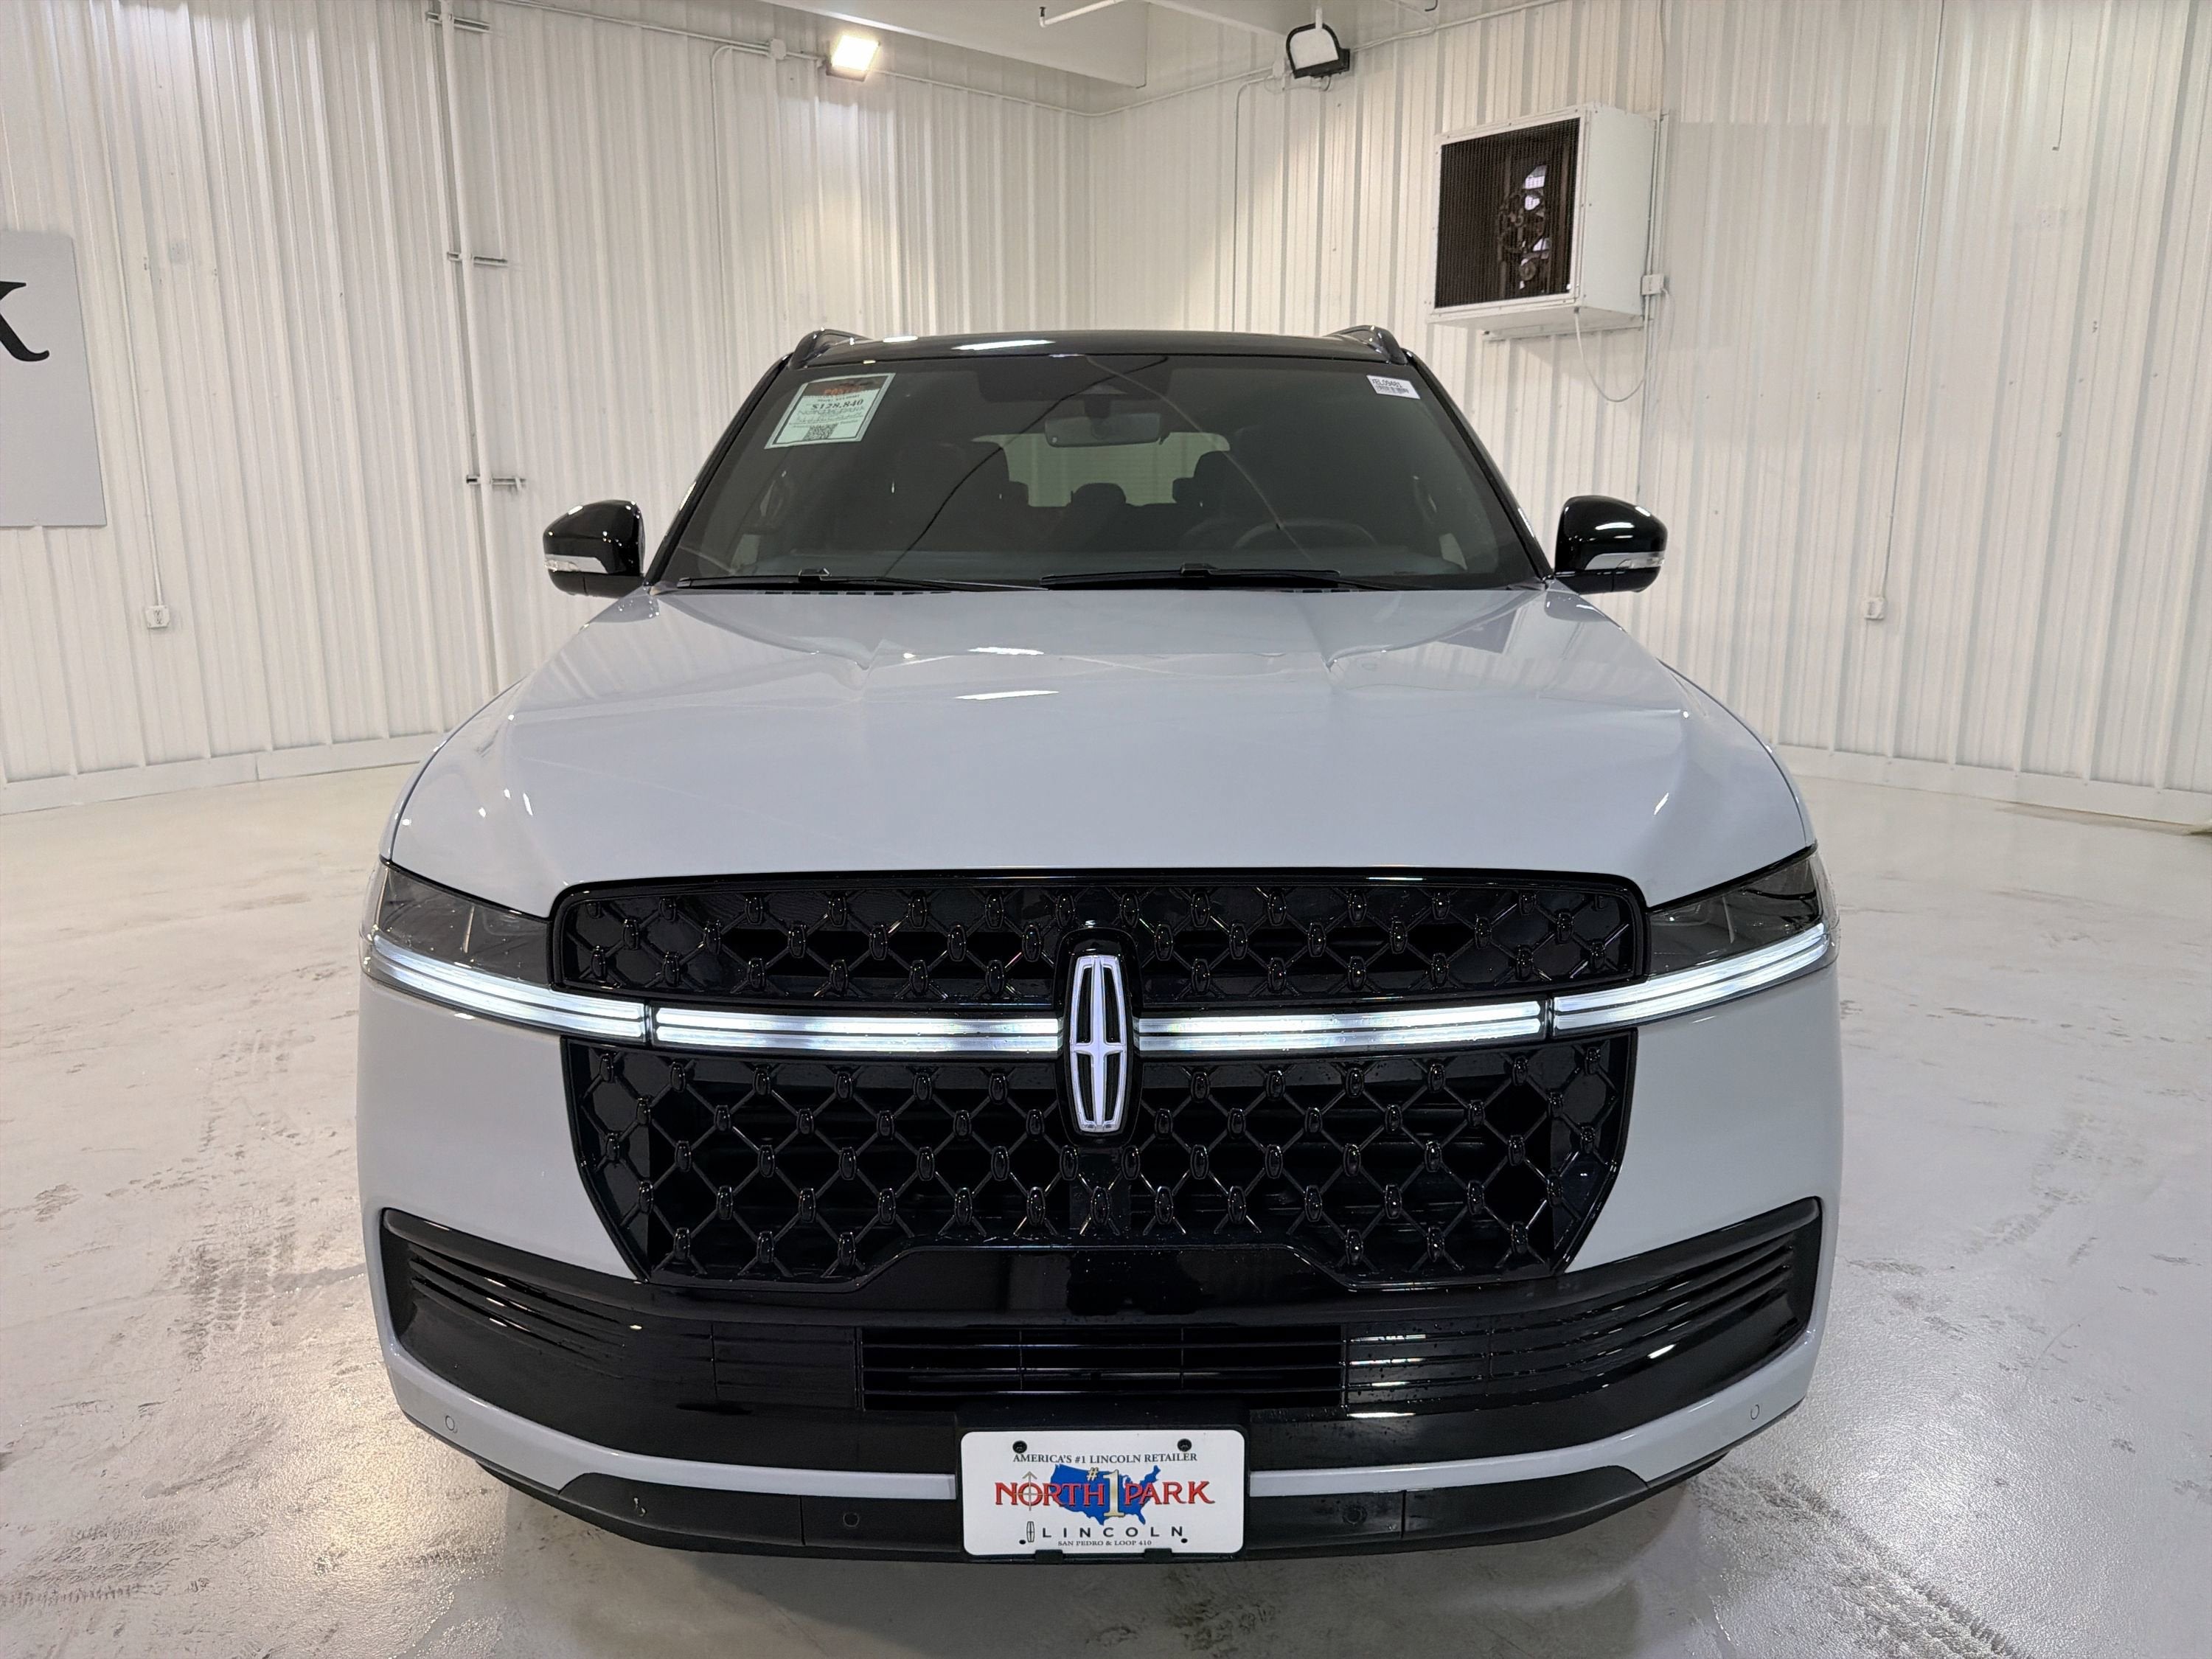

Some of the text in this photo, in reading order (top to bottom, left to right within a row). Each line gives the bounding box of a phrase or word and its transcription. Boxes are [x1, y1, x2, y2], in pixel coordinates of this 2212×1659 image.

[1012, 1453, 1198, 1464] AMERICA'S #1 LINCOLN RETAILER
[995, 1481, 1215, 1506] NORTH PARK
[1043, 1526, 1183, 1538] LINCOLN
